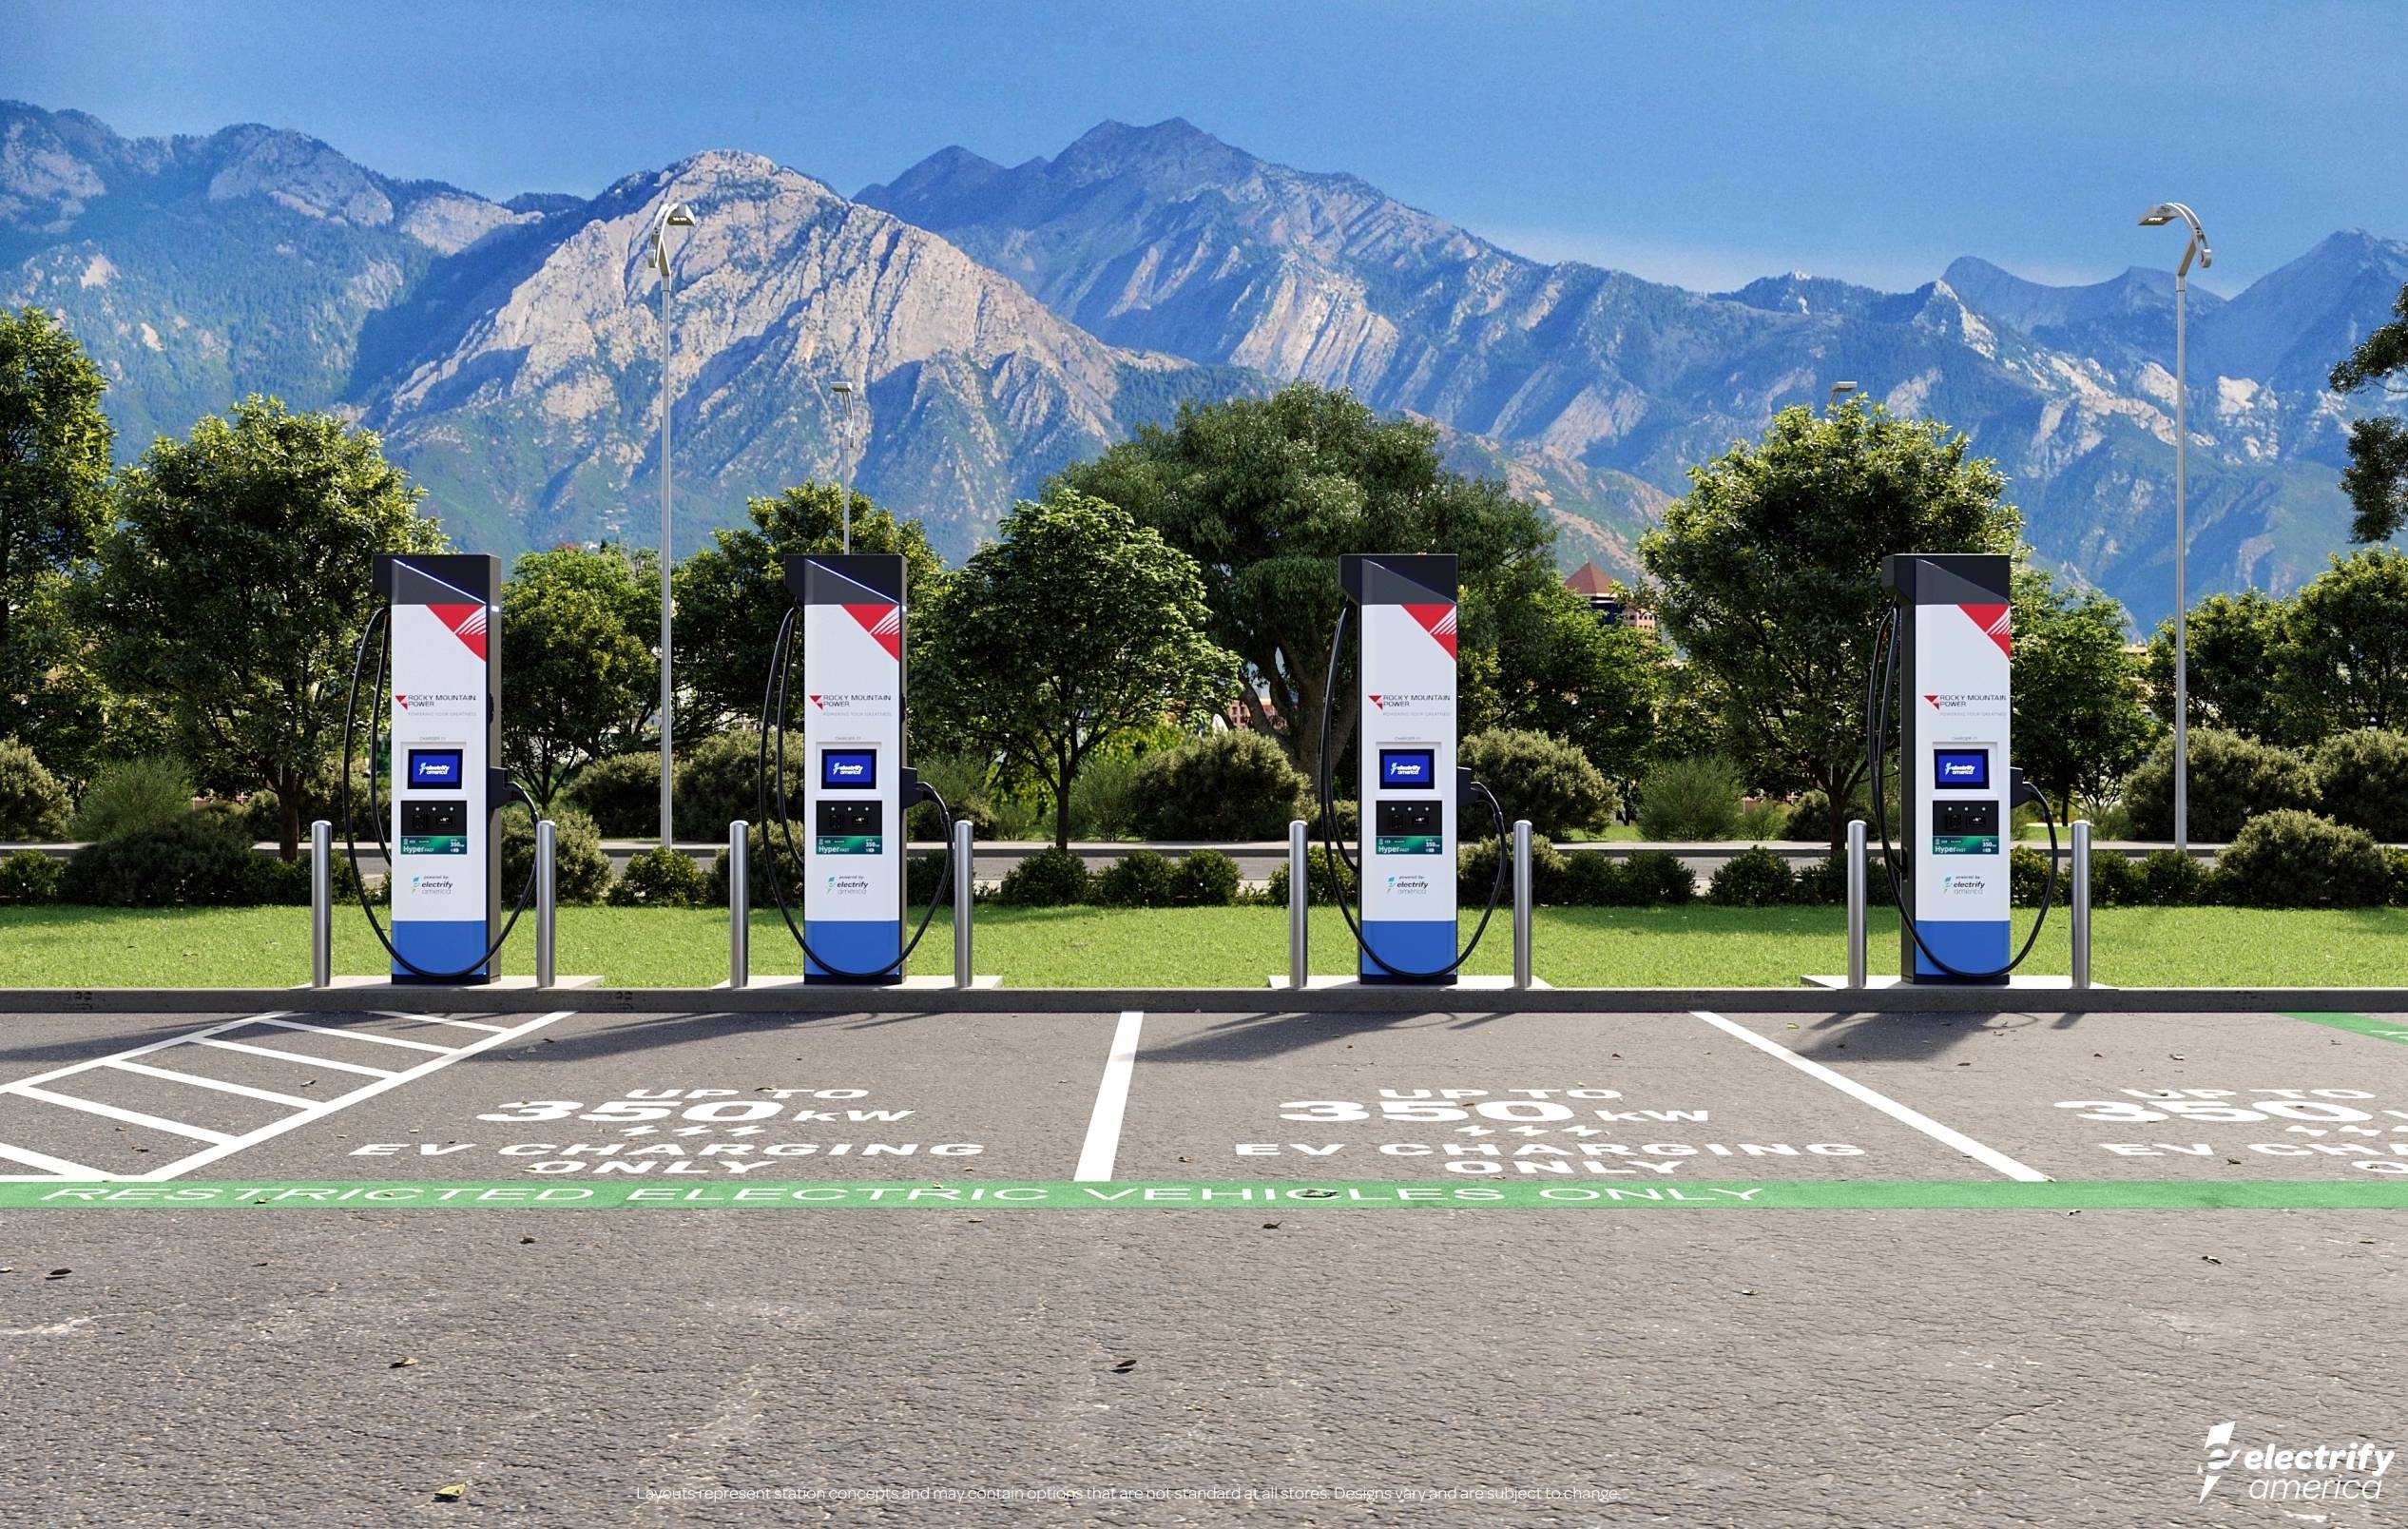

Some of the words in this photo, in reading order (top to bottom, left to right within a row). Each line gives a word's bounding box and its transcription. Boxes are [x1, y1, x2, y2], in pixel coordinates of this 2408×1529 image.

[403, 845, 424, 854] Hyper
[819, 845, 839, 854] Hyper
[1377, 845, 1399, 854] Hyper
[1935, 845, 1955, 854] Hyper
[626, 1089, 740, 1099] UP
[768, 1089, 869, 1099] TO
[1379, 1089, 1489, 1099] UP
[1508, 1089, 1623, 1099] TO
[2120, 1089, 2237, 1099] UP
[2249, 1089, 2377, 1099] TO
[476, 1101, 783, 1122] 350
[1279, 1101, 1575, 1122] 350
[2053, 1101, 2374, 1122] 350
[348, 1143, 476, 1156] EV
[497, 1143, 984, 1156] CHARGING
[1236, 1143, 1345, 1156] EV
[1379, 1143, 1866, 1156] CHARGING
[2099, 1143, 2215, 1156] EV
[2247, 1143, 2408, 1156] CH
[530, 1160, 777, 1174] ONLY
[1444, 1160, 1685, 1174] ONLY
[39, 1188, 594, 1202] RESTRICTED
[626, 1188, 1048, 1202] ELECTRIC
[1084, 1188, 1506, 1202] VEHICLES
[1538, 1188, 1763, 1202] ONLY
